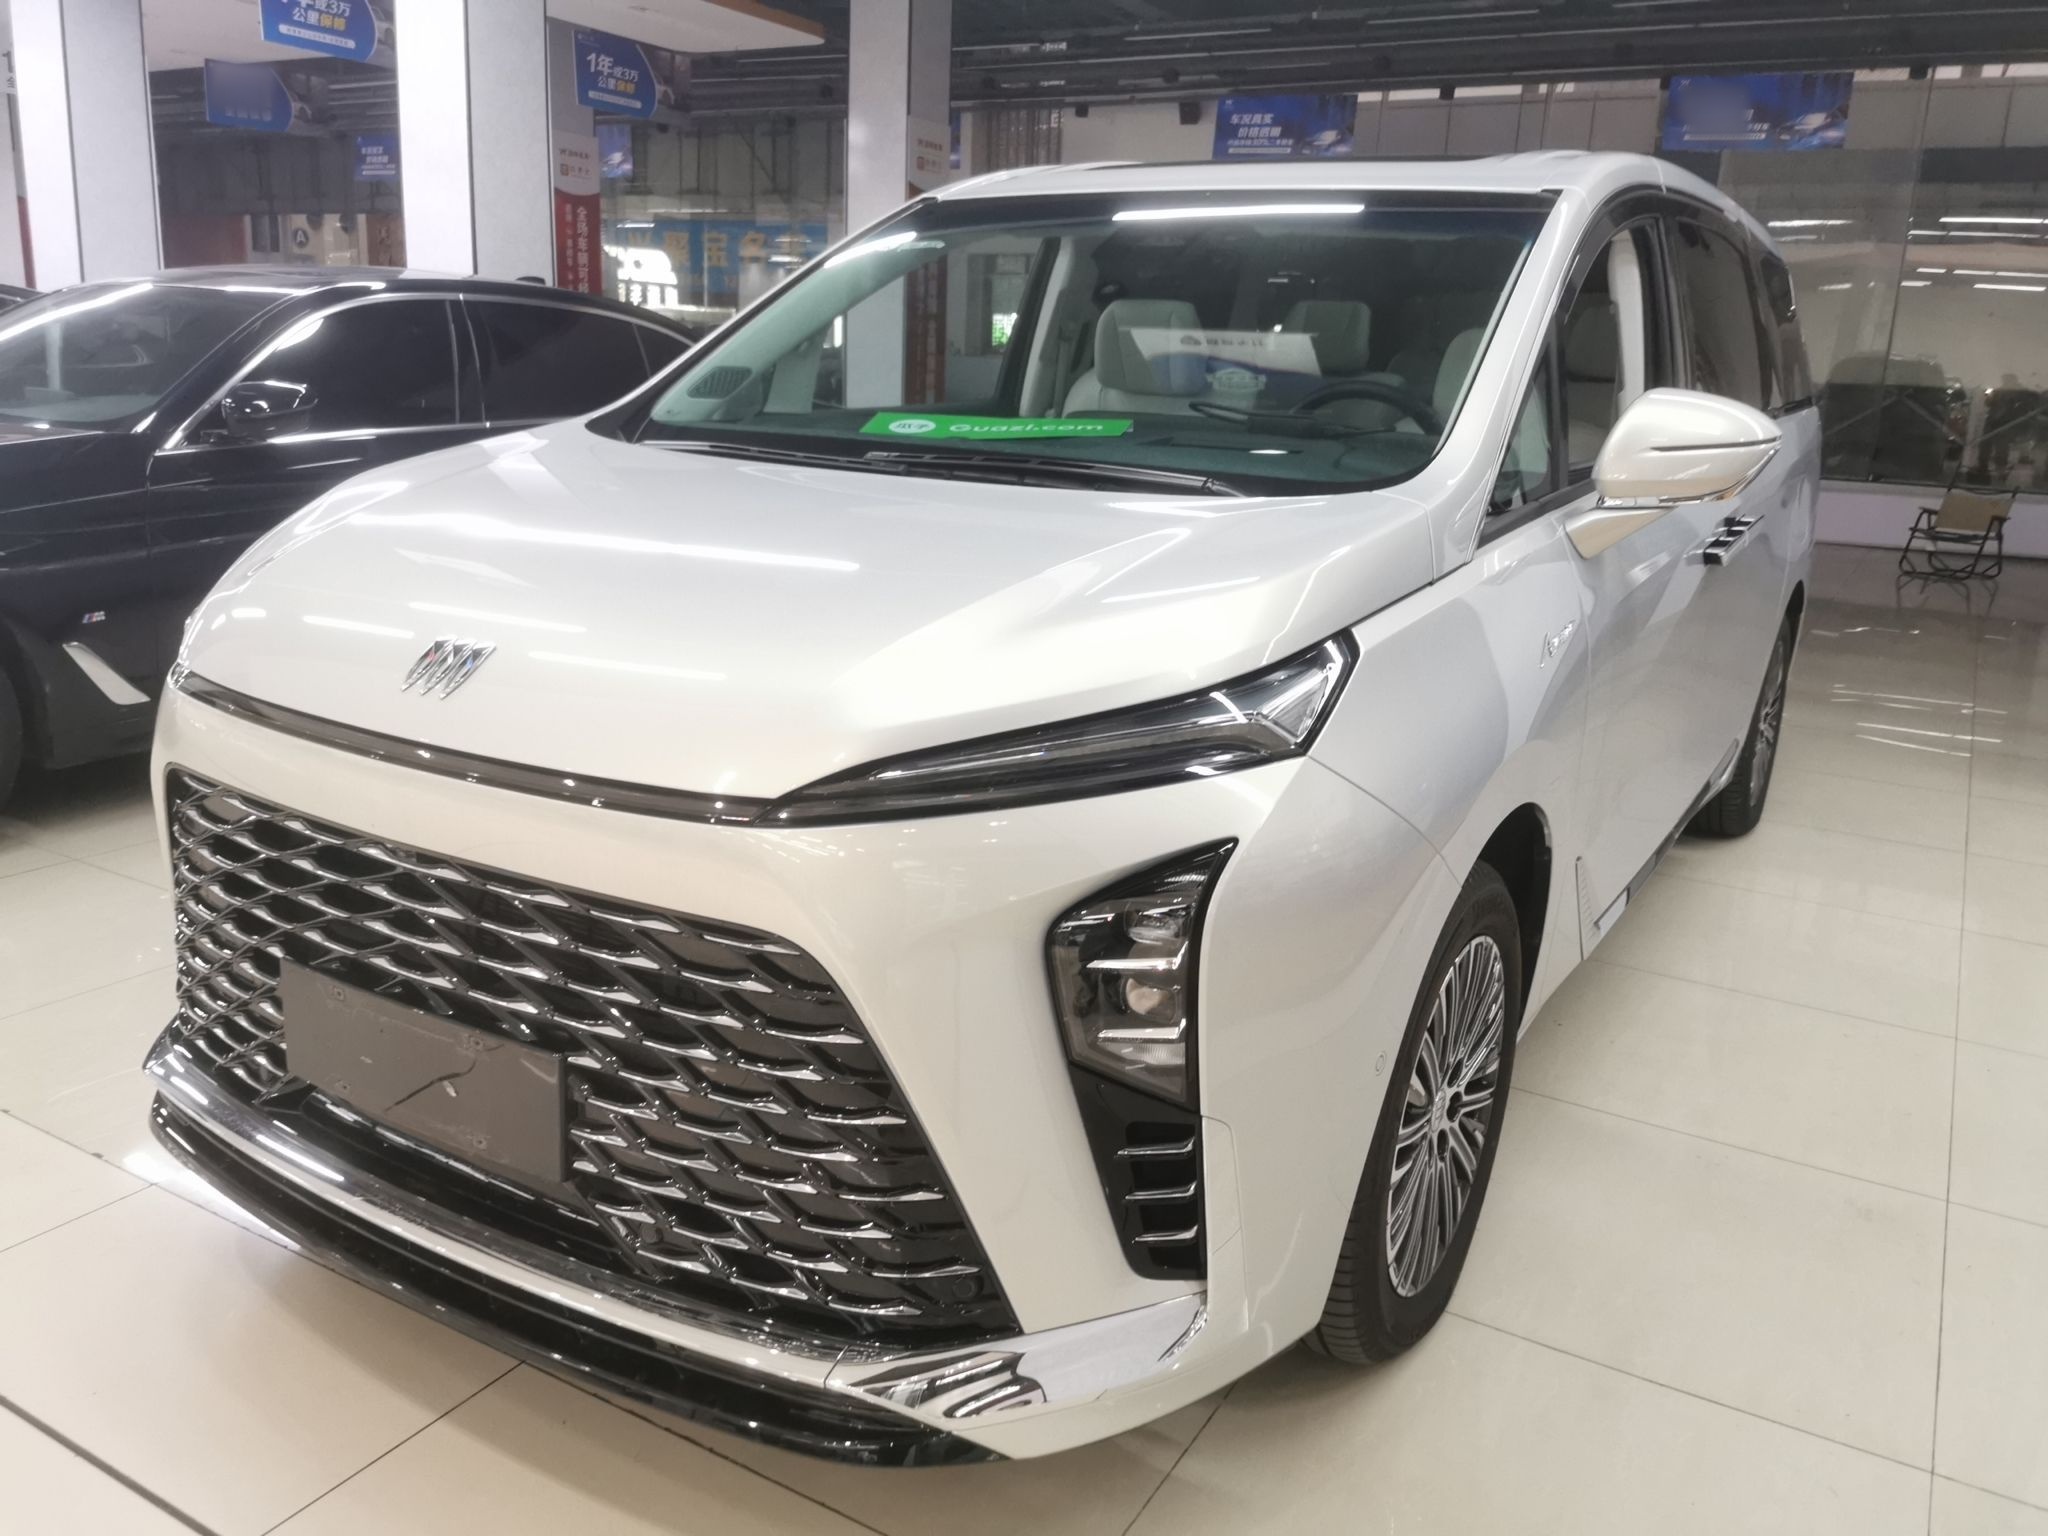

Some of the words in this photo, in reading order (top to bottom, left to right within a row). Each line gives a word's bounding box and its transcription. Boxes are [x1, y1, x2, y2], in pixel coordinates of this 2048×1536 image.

[586, 52, 640, 83] 1年或3万
[949, 422, 1104, 433] Guazi.com
